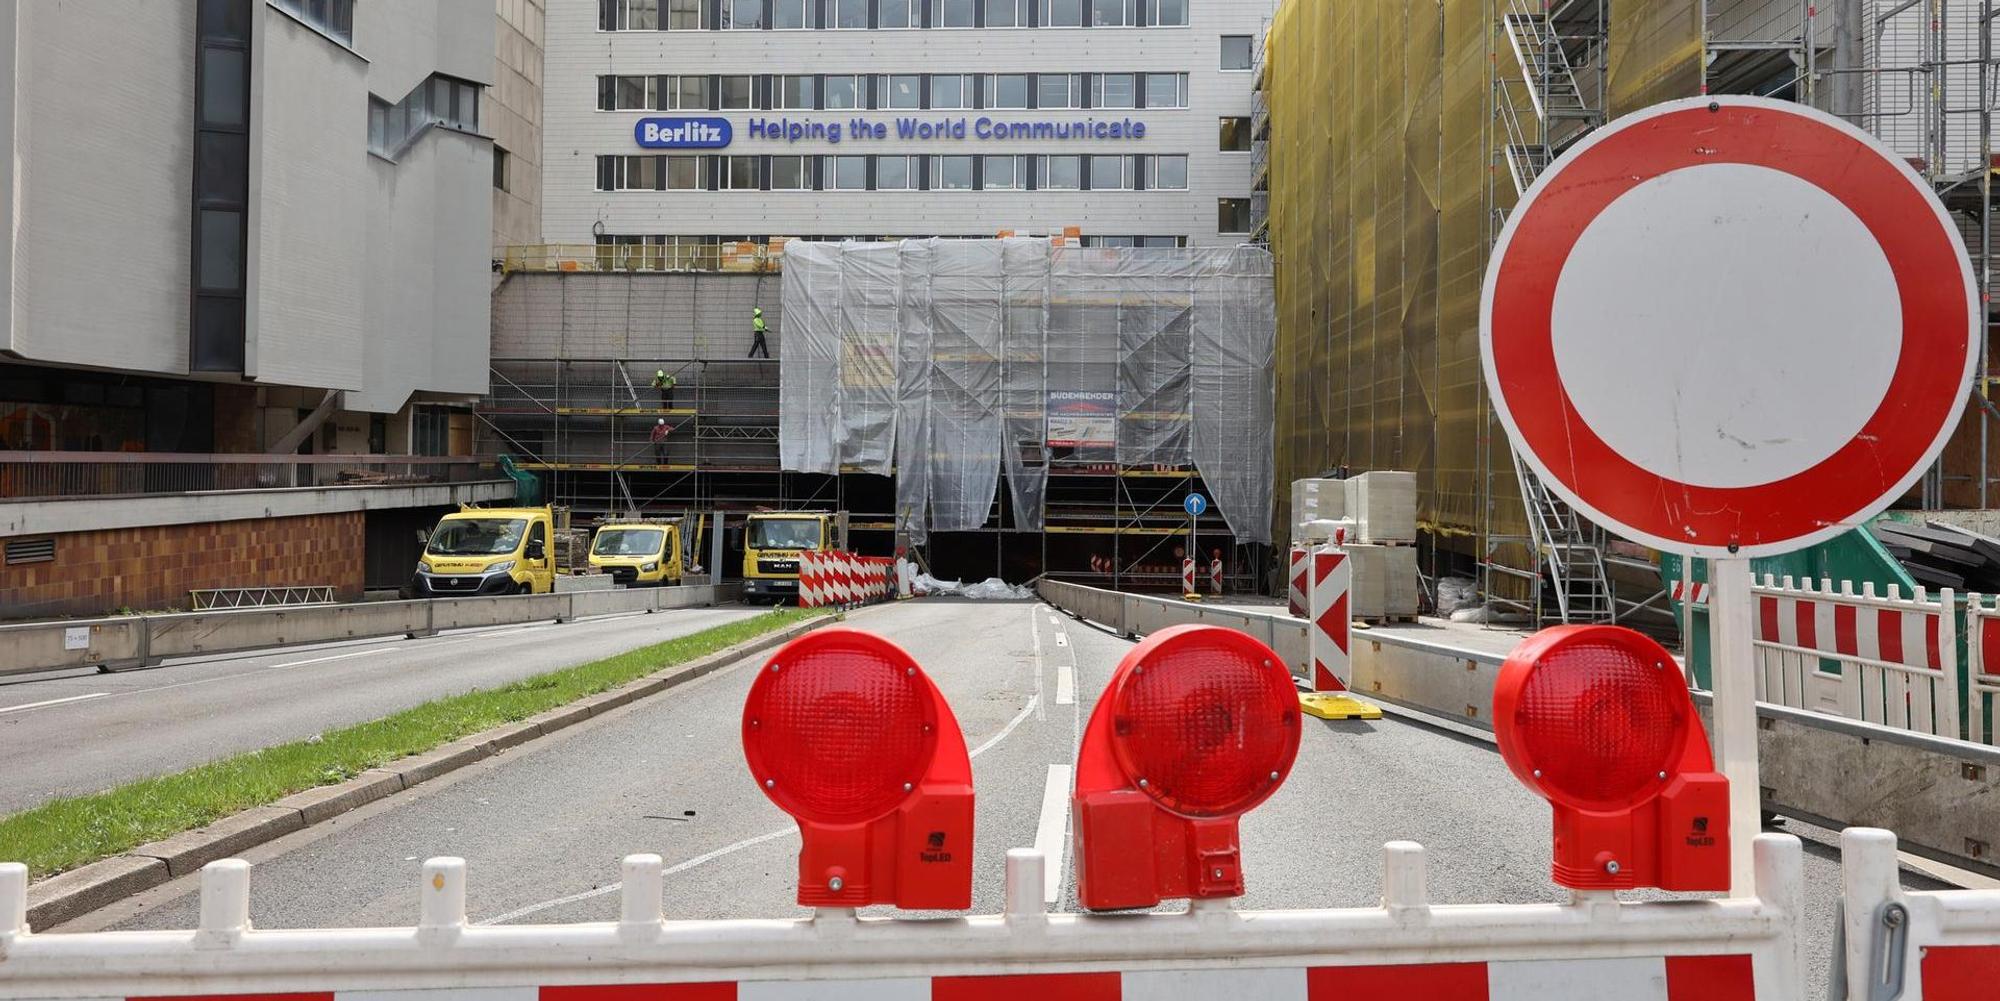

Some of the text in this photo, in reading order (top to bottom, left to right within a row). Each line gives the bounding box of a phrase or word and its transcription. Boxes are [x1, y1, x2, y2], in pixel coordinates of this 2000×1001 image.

[644, 122, 721, 142] Berlitz
[749, 117, 1146, 144] Helping the World Communicate
[920, 852, 952, 863] TopLED
